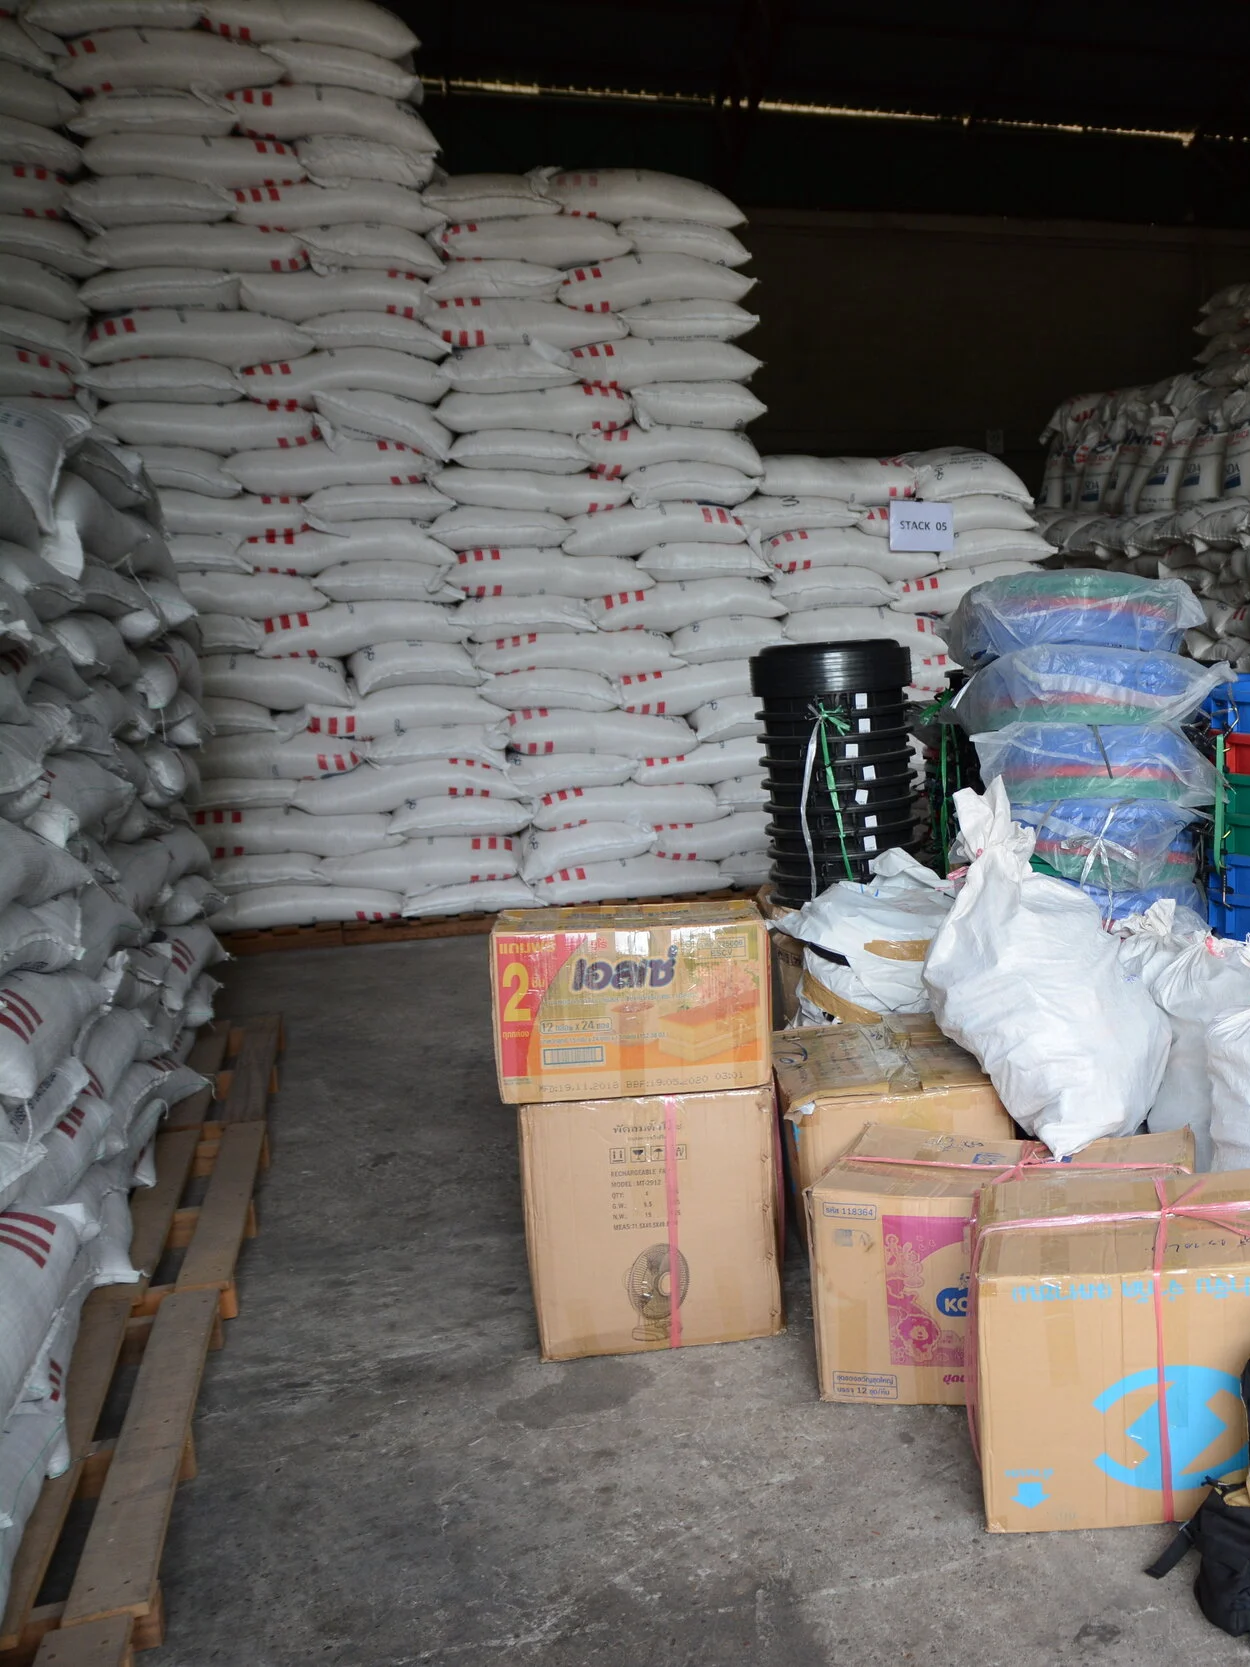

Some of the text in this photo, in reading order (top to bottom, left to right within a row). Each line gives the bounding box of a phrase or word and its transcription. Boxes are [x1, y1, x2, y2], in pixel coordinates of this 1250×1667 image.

[900, 521, 947, 531] STACK 05
[503, 962, 531, 1022] 2
[541, 1021, 554, 1032] 12
[581, 1020, 594, 1029] 24
[610, 1168, 657, 1177] RECHARGEABLE
[841, 1207, 873, 1216] 118364
[857, 1386, 867, 1394] 12
